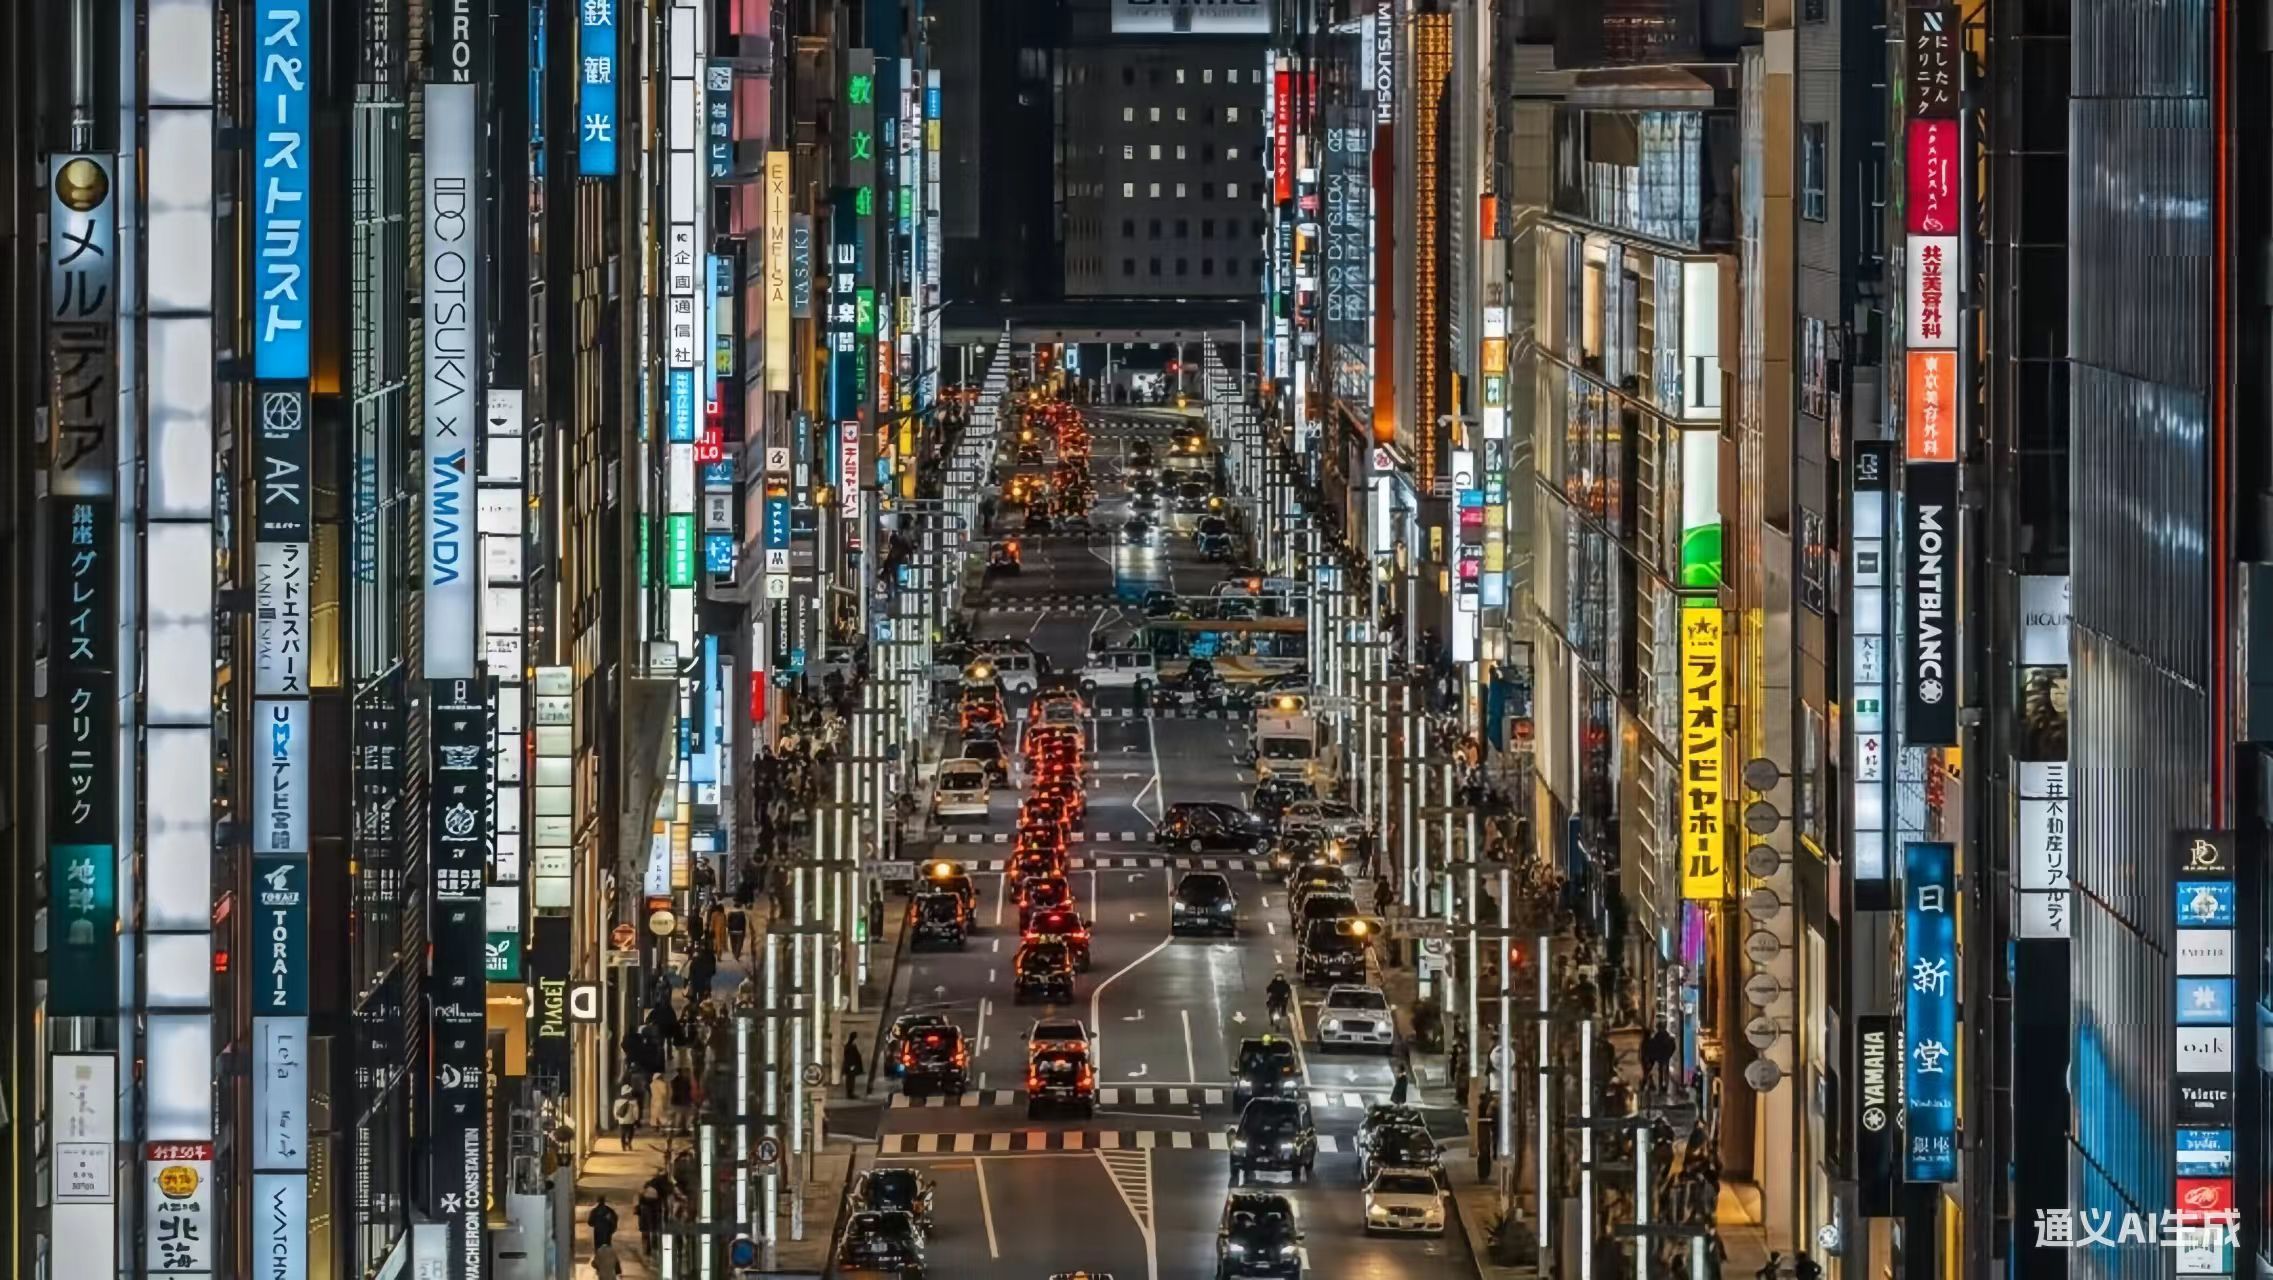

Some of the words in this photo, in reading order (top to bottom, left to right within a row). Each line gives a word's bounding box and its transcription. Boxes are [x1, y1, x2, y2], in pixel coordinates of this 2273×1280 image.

[1378, 3, 1392, 124] MITSUKOSHI
[1917, 35, 1930, 115] クリニック
[1935, 35, 1949, 103] にしたん
[262, 9, 304, 342] スペーストラスト
[434, 251, 466, 405] OTSUKA
[433, 448, 466, 587] YAMADA
[1919, 505, 1943, 679] MONTBLANC
[1687, 655, 1718, 878] ライオンビヤホール
[272, 910, 288, 1006] TORAIZ
[540, 976, 566, 1037] PIAGET
[1864, 1031, 1885, 1106] YAMAHA
